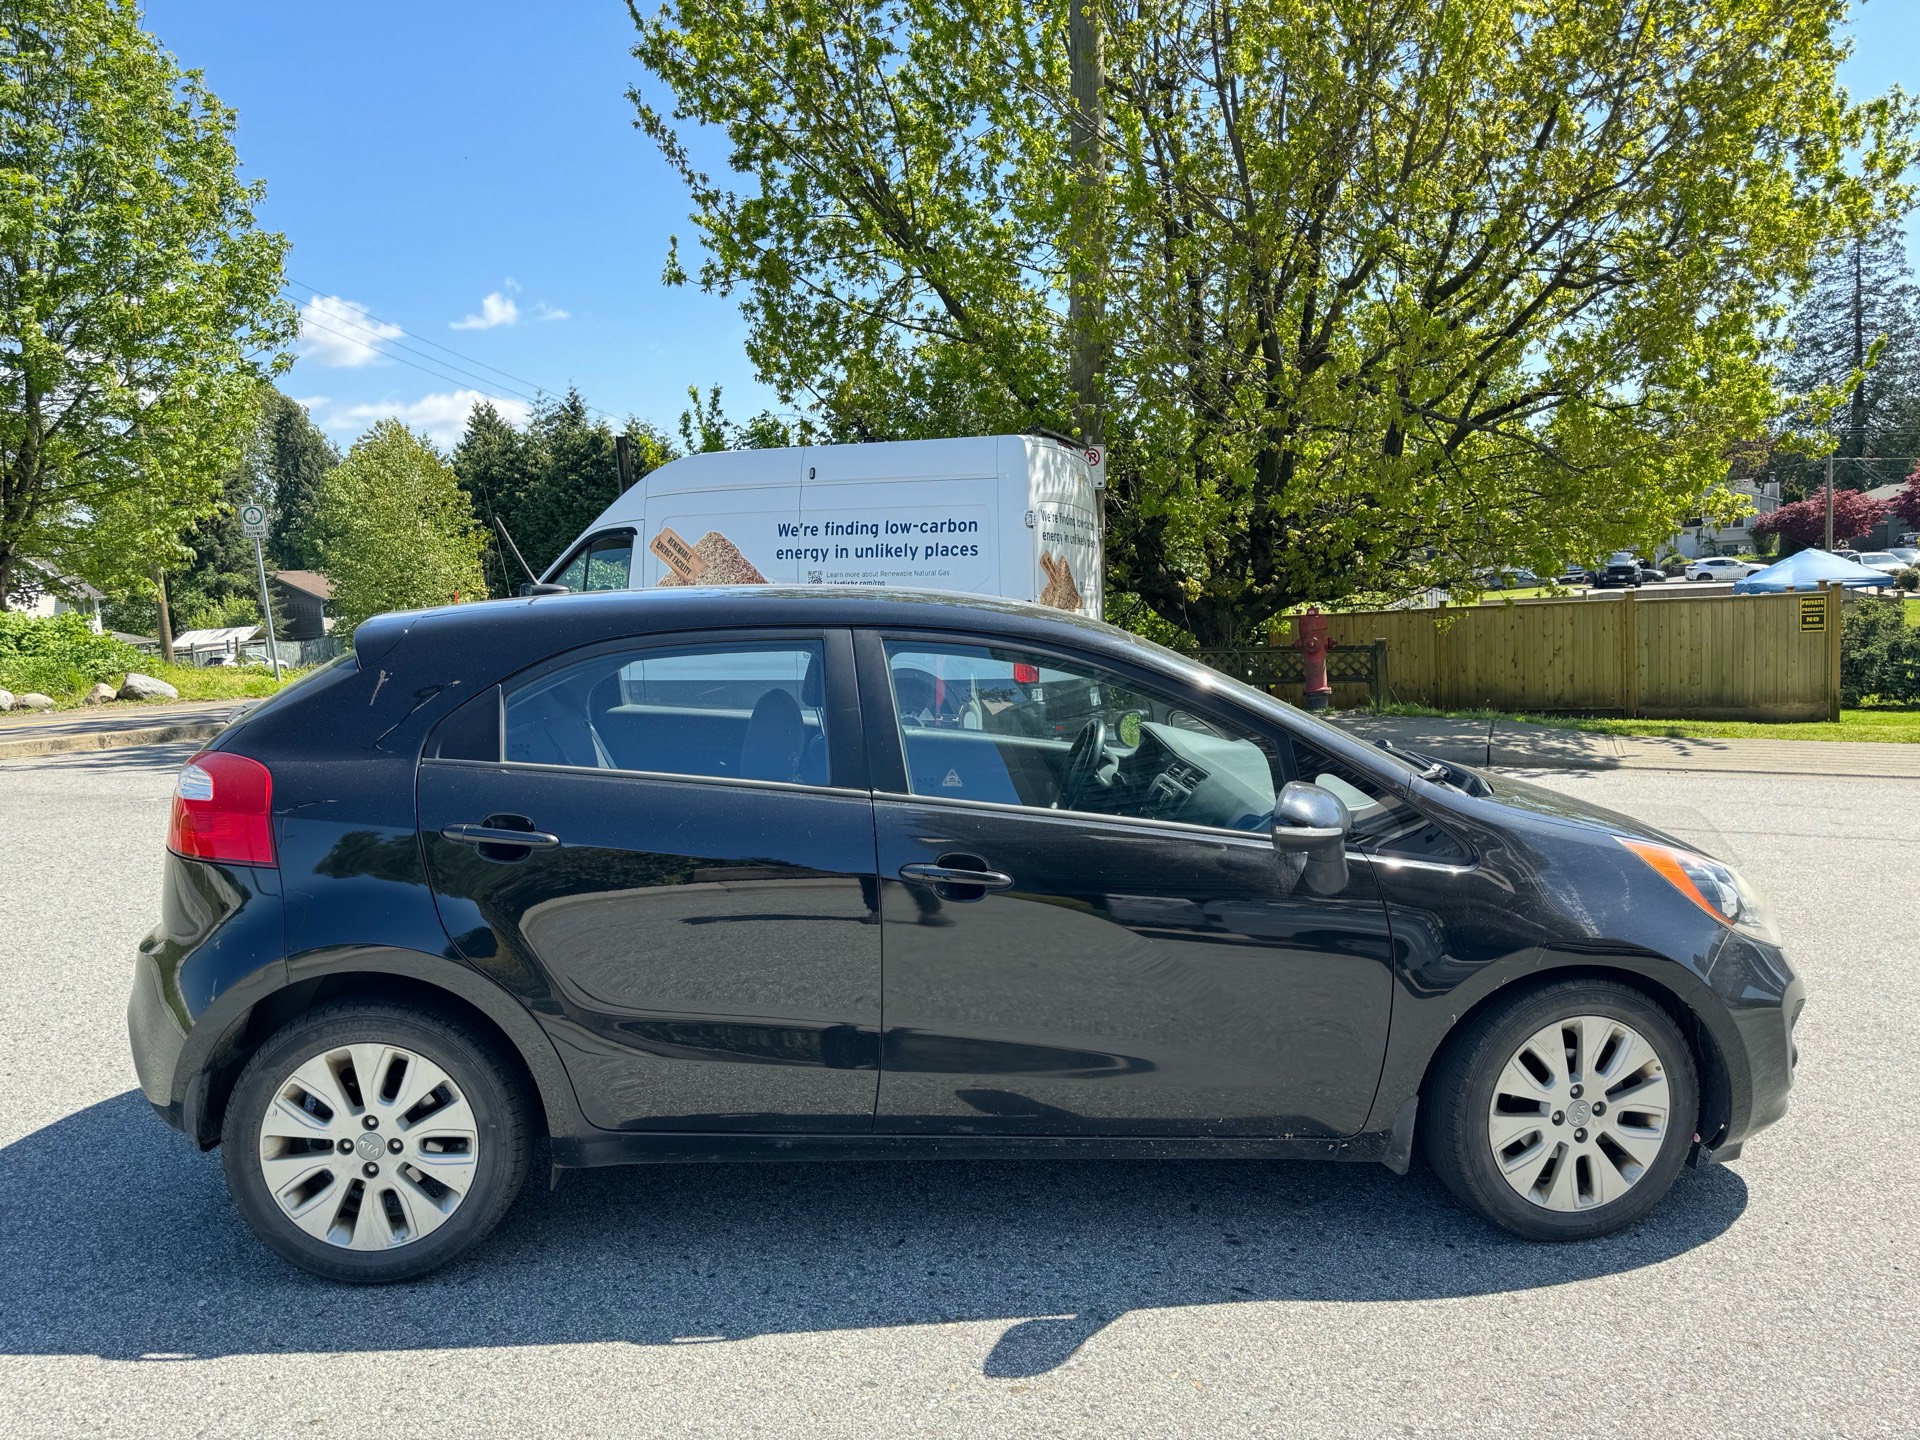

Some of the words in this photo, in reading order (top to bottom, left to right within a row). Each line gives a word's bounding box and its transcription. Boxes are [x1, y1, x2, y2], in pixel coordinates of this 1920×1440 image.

[778, 522, 819, 537] We're
[824, 520, 879, 538] finding
[884, 518, 978, 534] low-carbon
[1042, 531, 1063, 545] energy
[656, 541, 674, 559] ENERGY
[671, 556, 692, 576] FACILITY
[667, 536, 692, 562] RENEWABLE
[776, 546, 829, 563] energy
[835, 544, 849, 559] in
[855, 543, 918, 560] unlikely
[925, 542, 979, 560] places
[938, 569, 950, 577] Gas
[1572, 1105, 1587, 1125] KIA
[359, 1140, 380, 1157] KIA
